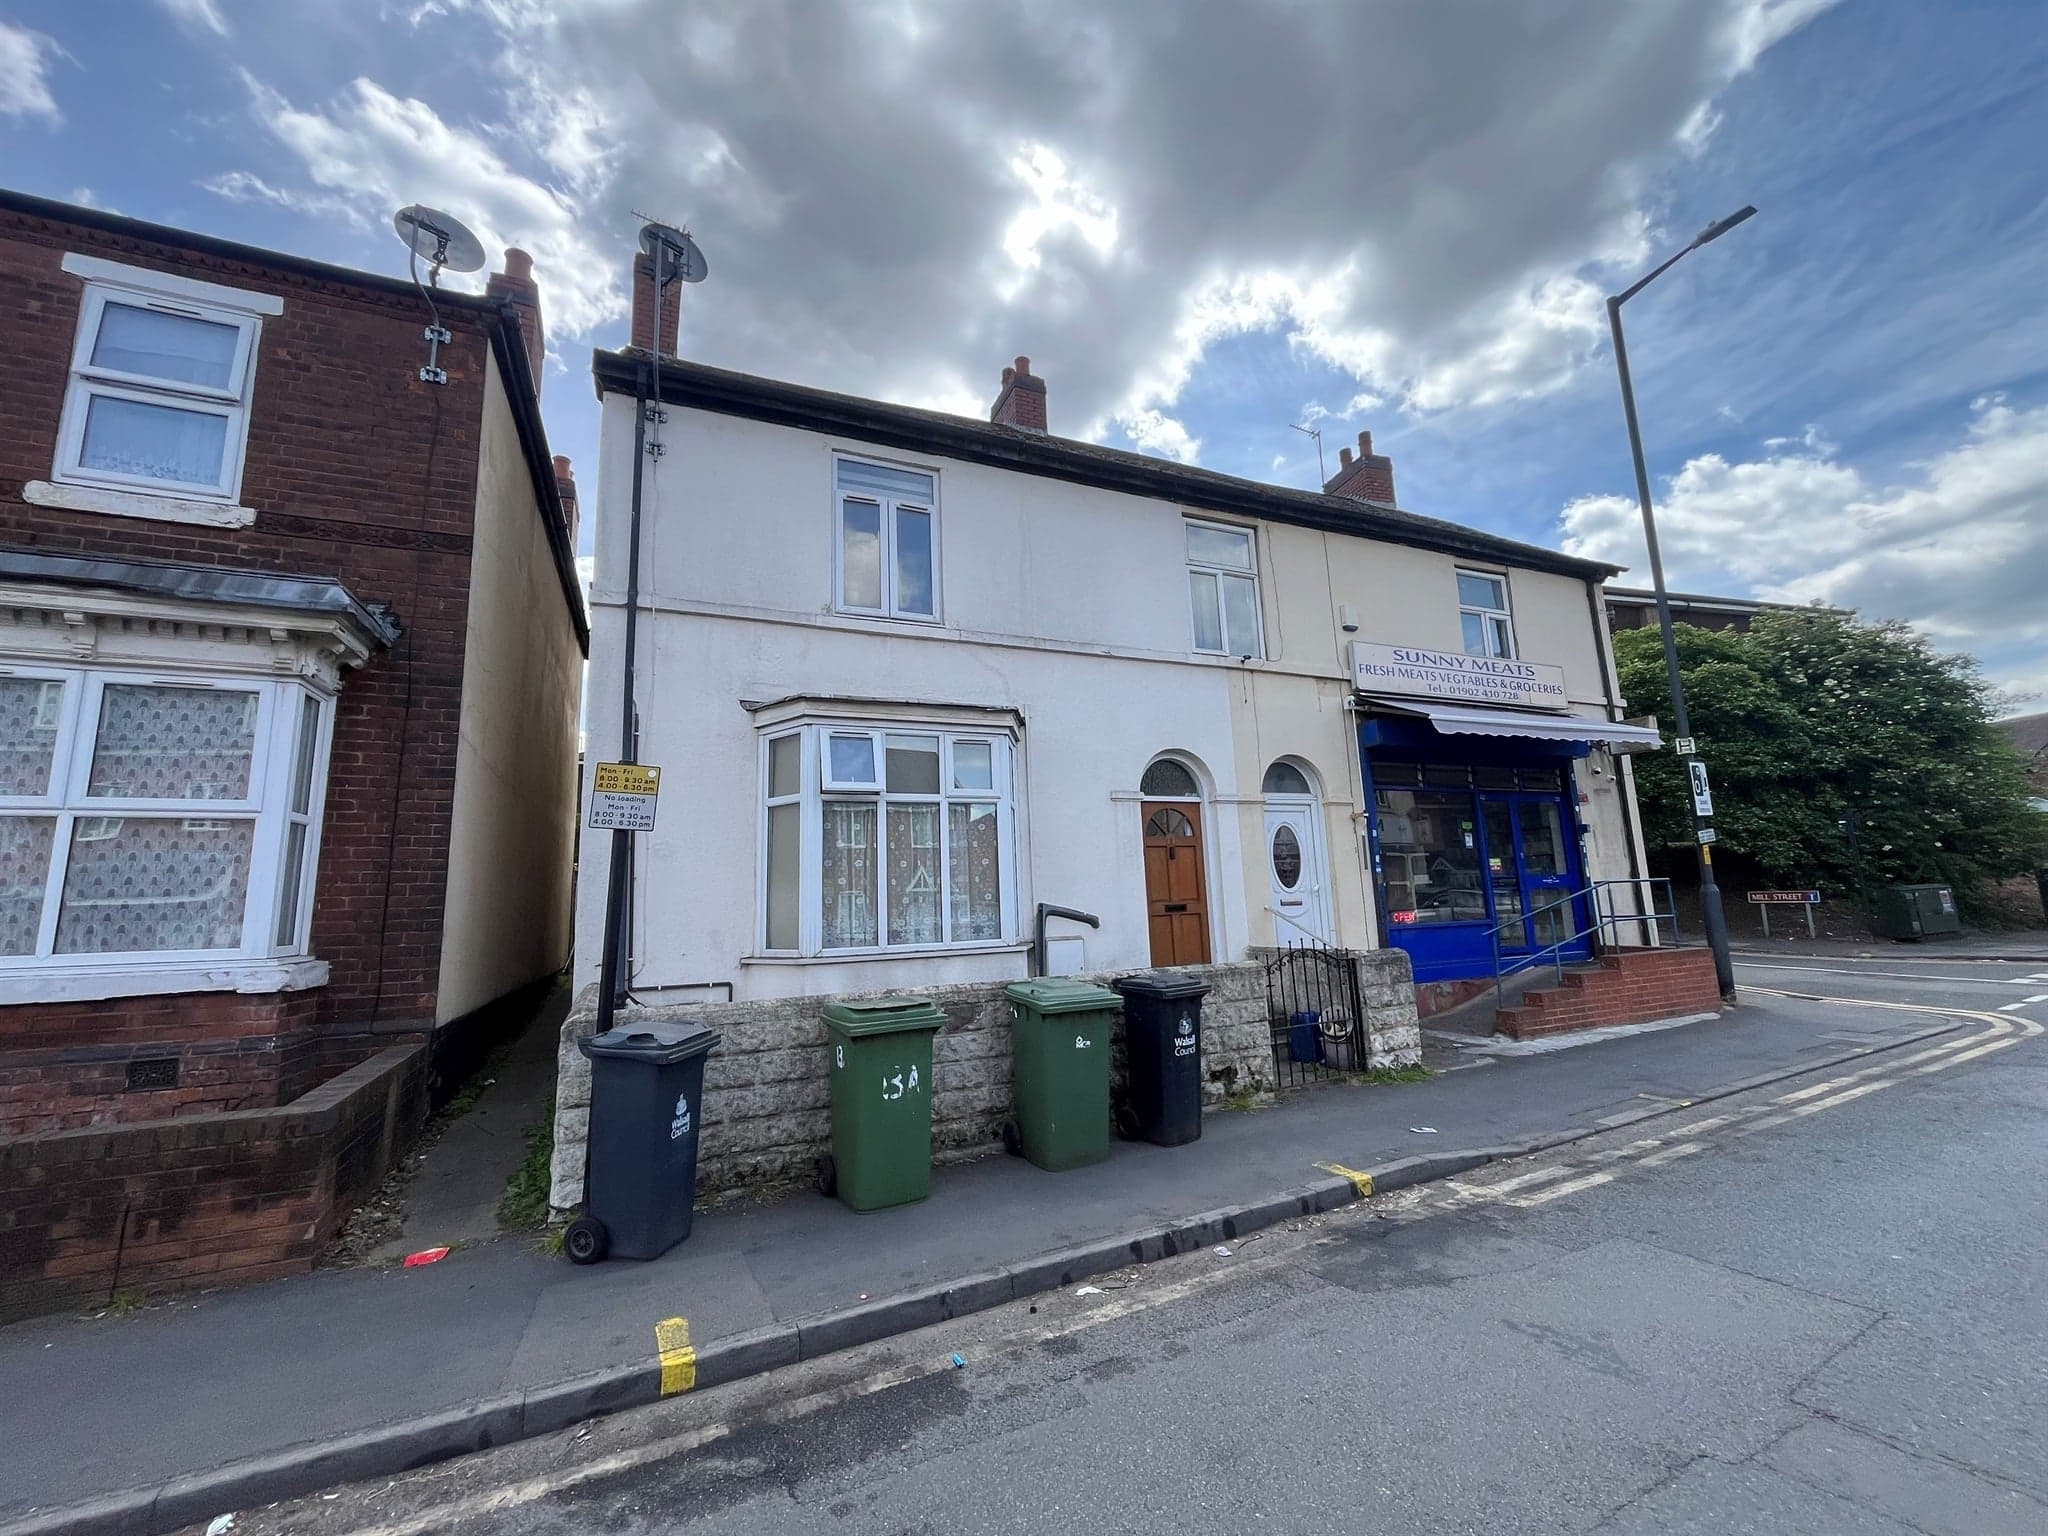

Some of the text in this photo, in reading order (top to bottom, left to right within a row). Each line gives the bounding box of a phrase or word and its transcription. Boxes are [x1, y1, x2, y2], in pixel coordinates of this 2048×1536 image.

[1393, 649, 1535, 677] SUNNY MEATS
[1359, 663, 1563, 695] FRESH MEATS VEGTABLES & GROCERIES
[1449, 687, 1479, 697] 01902
[1481, 689, 1499, 699] 410
[1502, 691, 1519, 700] 728
[618, 795, 646, 804] loading
[1751, 893, 1803, 901] MILL STREET
[1393, 912, 1415, 922] OPEN
